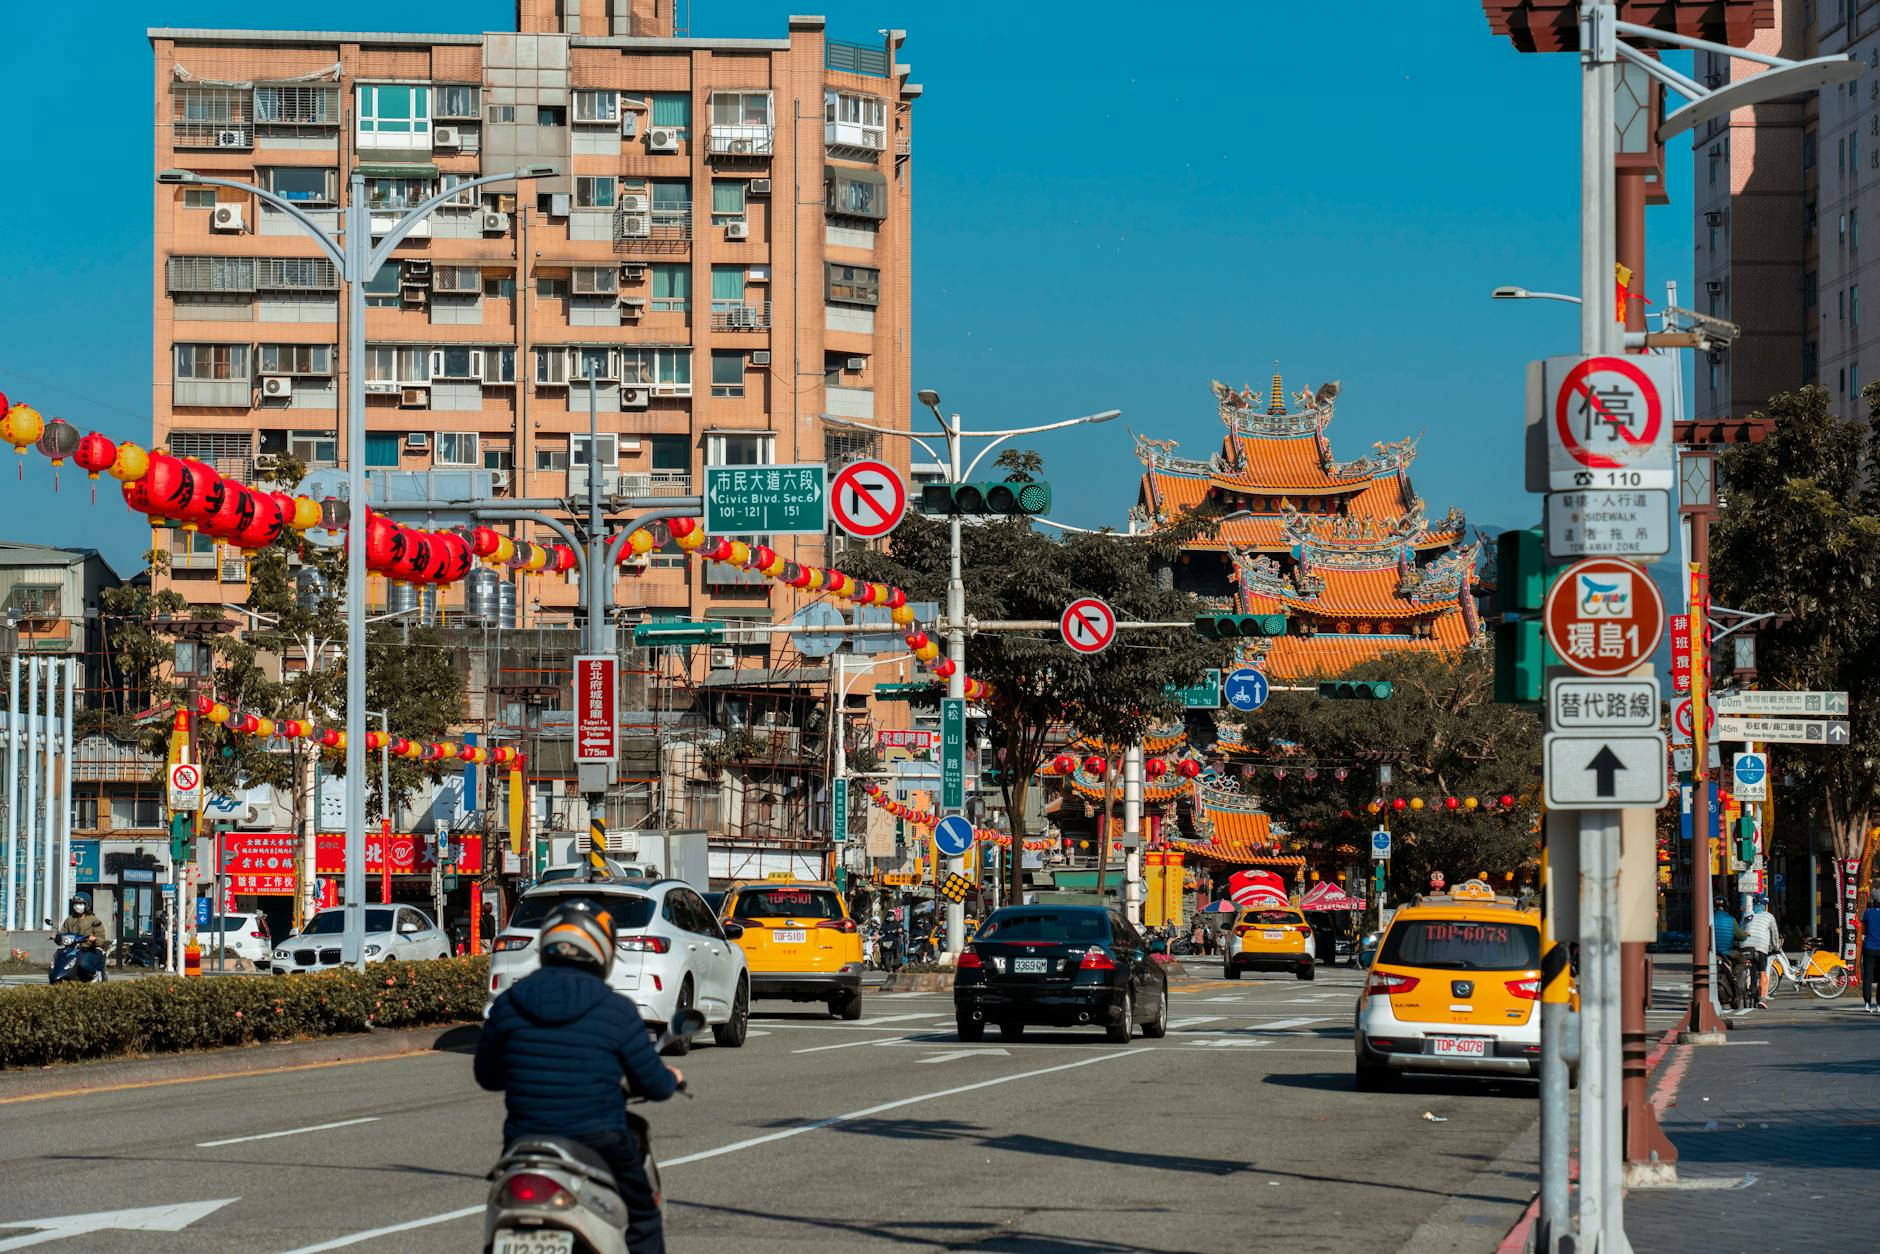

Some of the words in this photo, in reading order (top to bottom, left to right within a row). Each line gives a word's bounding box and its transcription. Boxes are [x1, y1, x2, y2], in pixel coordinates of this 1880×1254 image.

[1578, 385, 1634, 442] 停
[717, 470, 814, 491] 市民大道六段
[1607, 472, 1641, 486] 110
[718, 494, 748, 504] Civic
[751, 494, 781, 504] Blvd.
[784, 505, 800, 516] 151
[1616, 542, 1640, 552] ZONE
[1567, 621, 1639, 659] 環島1
[1674, 617, 1690, 687] 排班攬客
[590, 660, 602, 719] 台北府城隍廟
[1561, 694, 1650, 718] 替代路線
[947, 710, 959, 769] 松山路
[584, 748, 608, 757] 175m
[768, 893, 812, 905] TDF-5101
[1425, 925, 1508, 943] TDP-6078
[1436, 1038, 1483, 1054] TDP-6078
